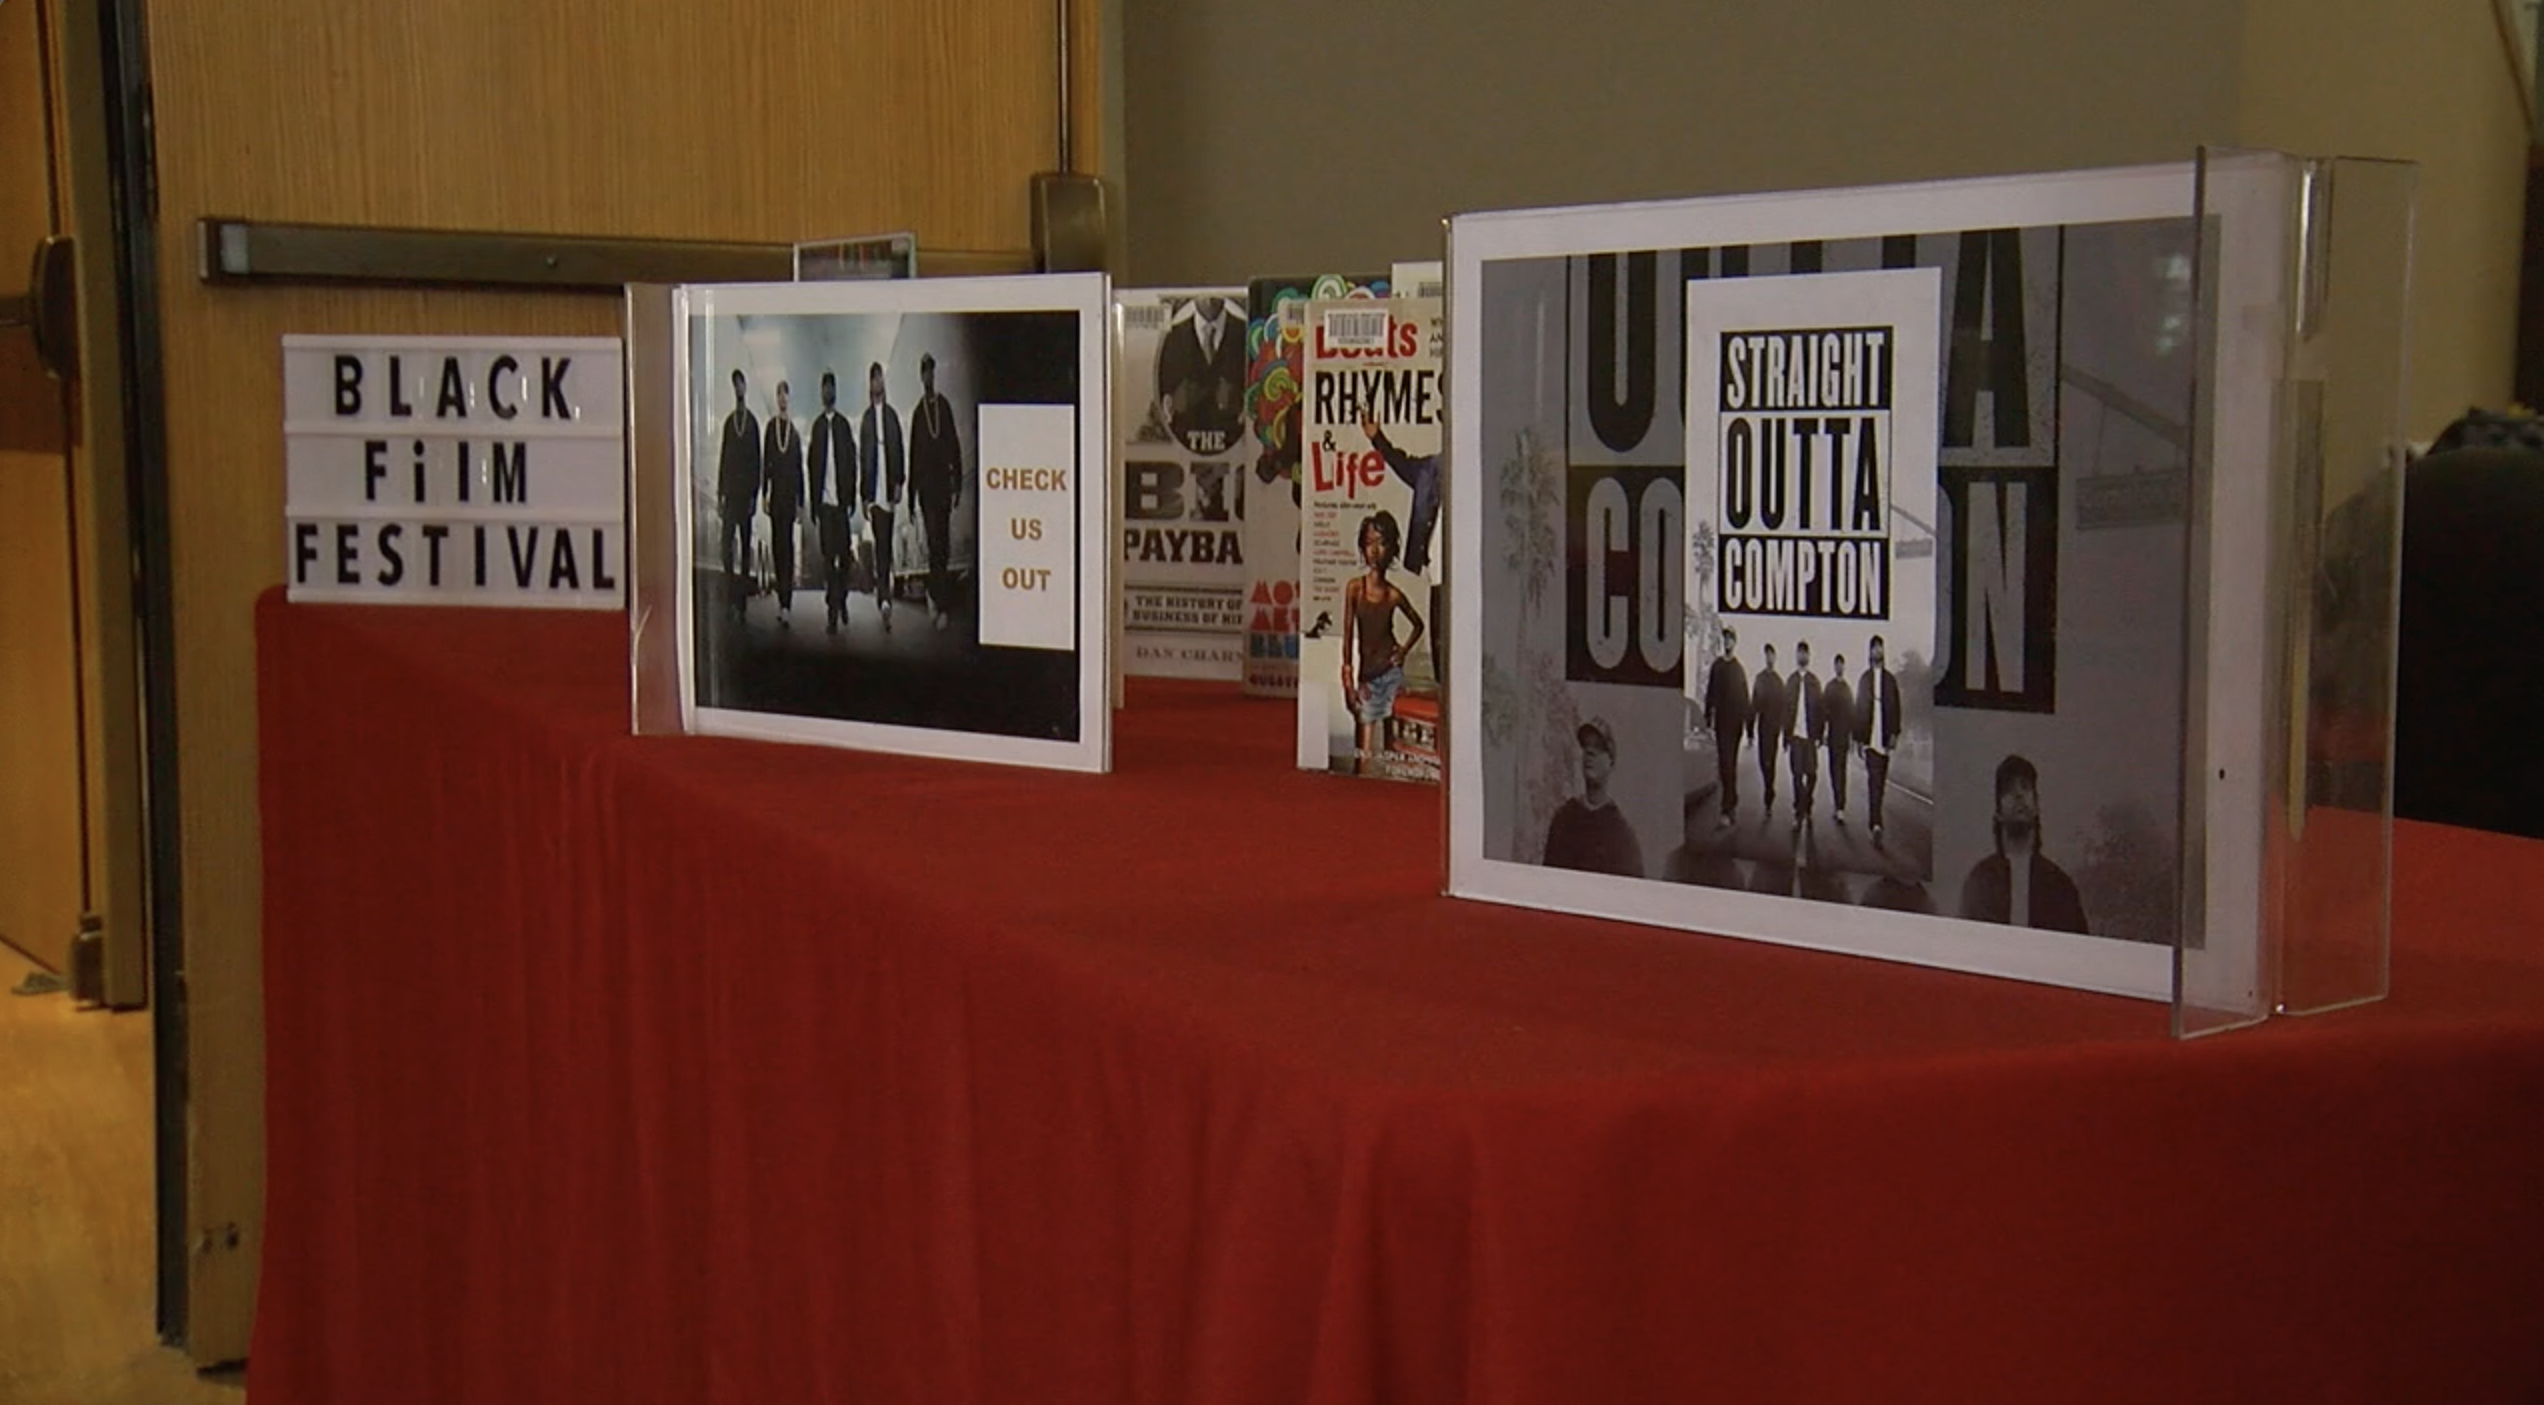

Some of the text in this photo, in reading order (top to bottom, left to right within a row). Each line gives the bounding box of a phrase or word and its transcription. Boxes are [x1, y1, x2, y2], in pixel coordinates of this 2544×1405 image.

[335, 354, 572, 420] BLACK
[1726, 331, 1885, 409] STRAIGHT
[1315, 370, 1443, 425] RHYME
[1187, 431, 1226, 451] THE
[1322, 429, 1336, 452] &
[986, 468, 1068, 492] CHECK
[1311, 441, 1385, 499] Life
[1725, 416, 1881, 531] OUTTA
[1125, 461, 1244, 523] BI
[1011, 518, 1043, 541] US
[295, 523, 616, 590] FESTIVAL
[1725, 537, 1881, 616] COMPTON
[1002, 567, 1051, 592] OUT
[1133, 609, 1199, 624] BUSINESS
[1202, 612, 1219, 625] OF
[1136, 595, 1163, 607] THE
[1166, 597, 1224, 611] HISTORY
[1137, 646, 1174, 660] DAN
